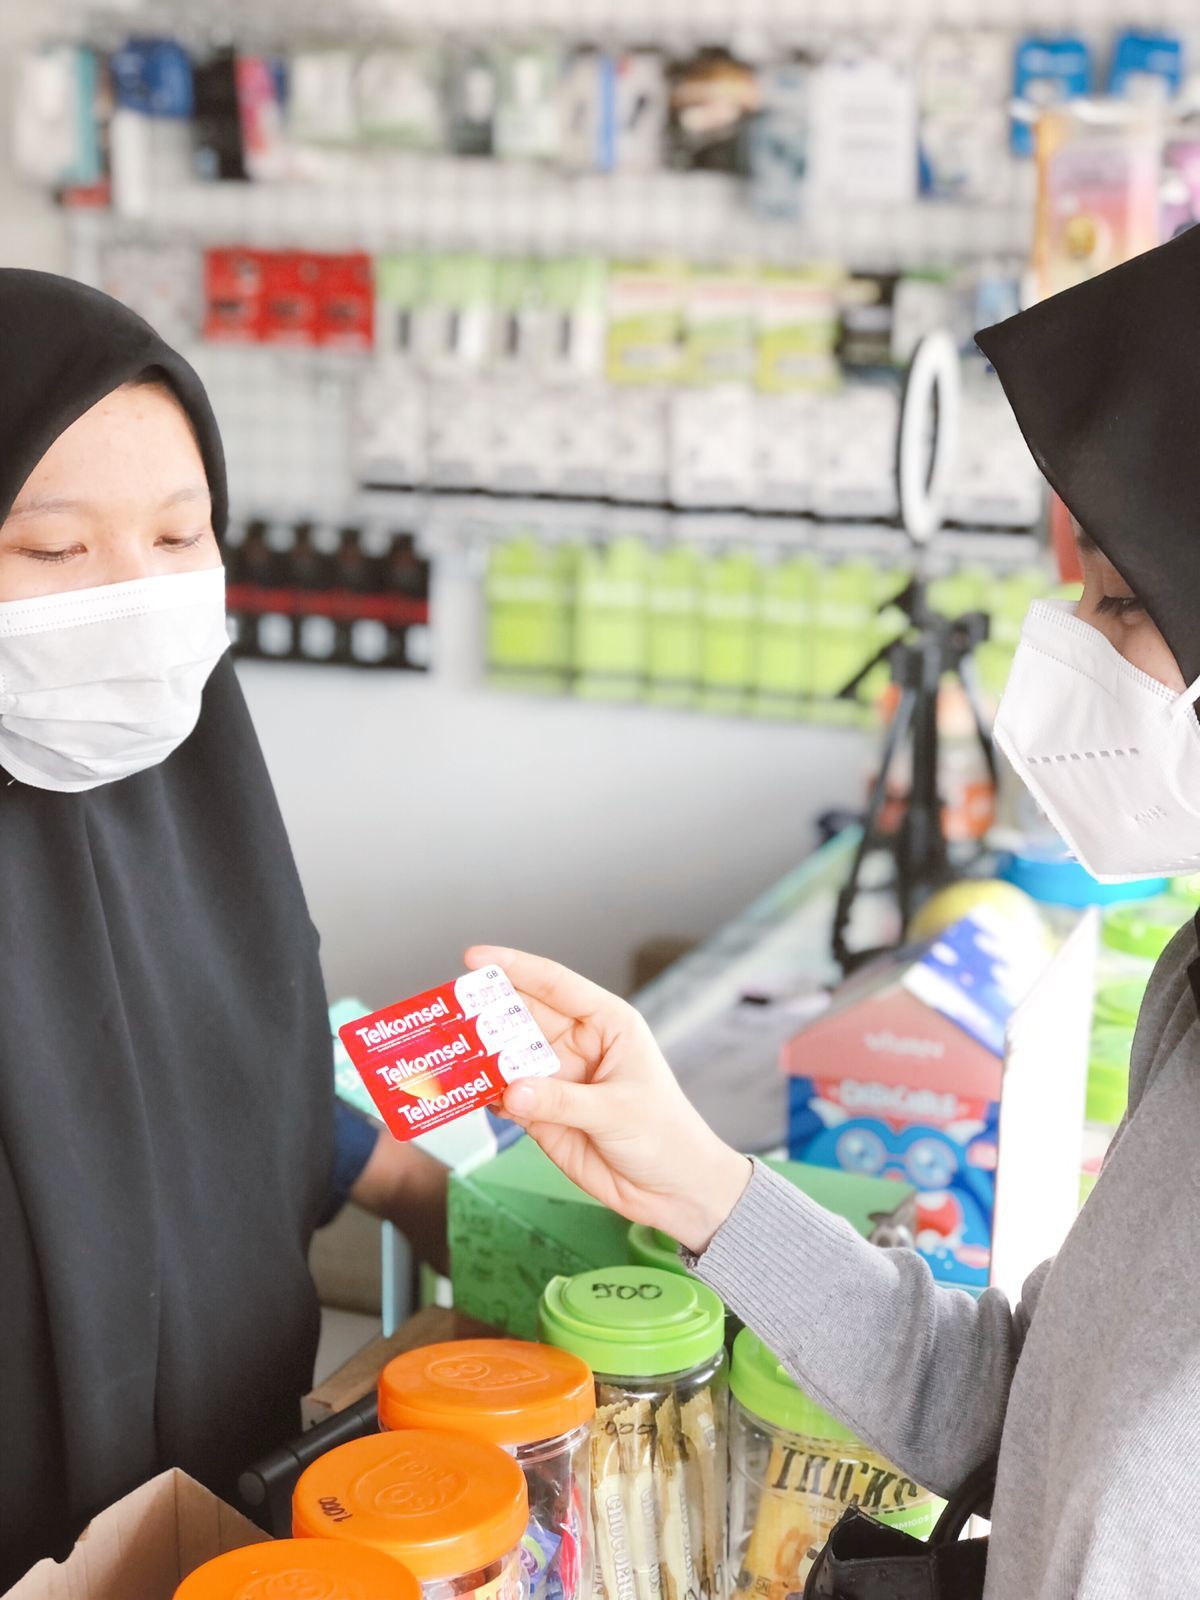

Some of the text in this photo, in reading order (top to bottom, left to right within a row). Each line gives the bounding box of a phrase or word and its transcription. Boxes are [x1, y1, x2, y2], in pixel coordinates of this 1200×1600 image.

[486, 969, 499, 980] GB
[355, 996, 450, 1047] Telkomsel
[508, 1004, 521, 1015] GB
[376, 1033, 471, 1086] Telkomsel
[530, 1041, 543, 1052] GB
[397, 1070, 494, 1125] Telkomsel
